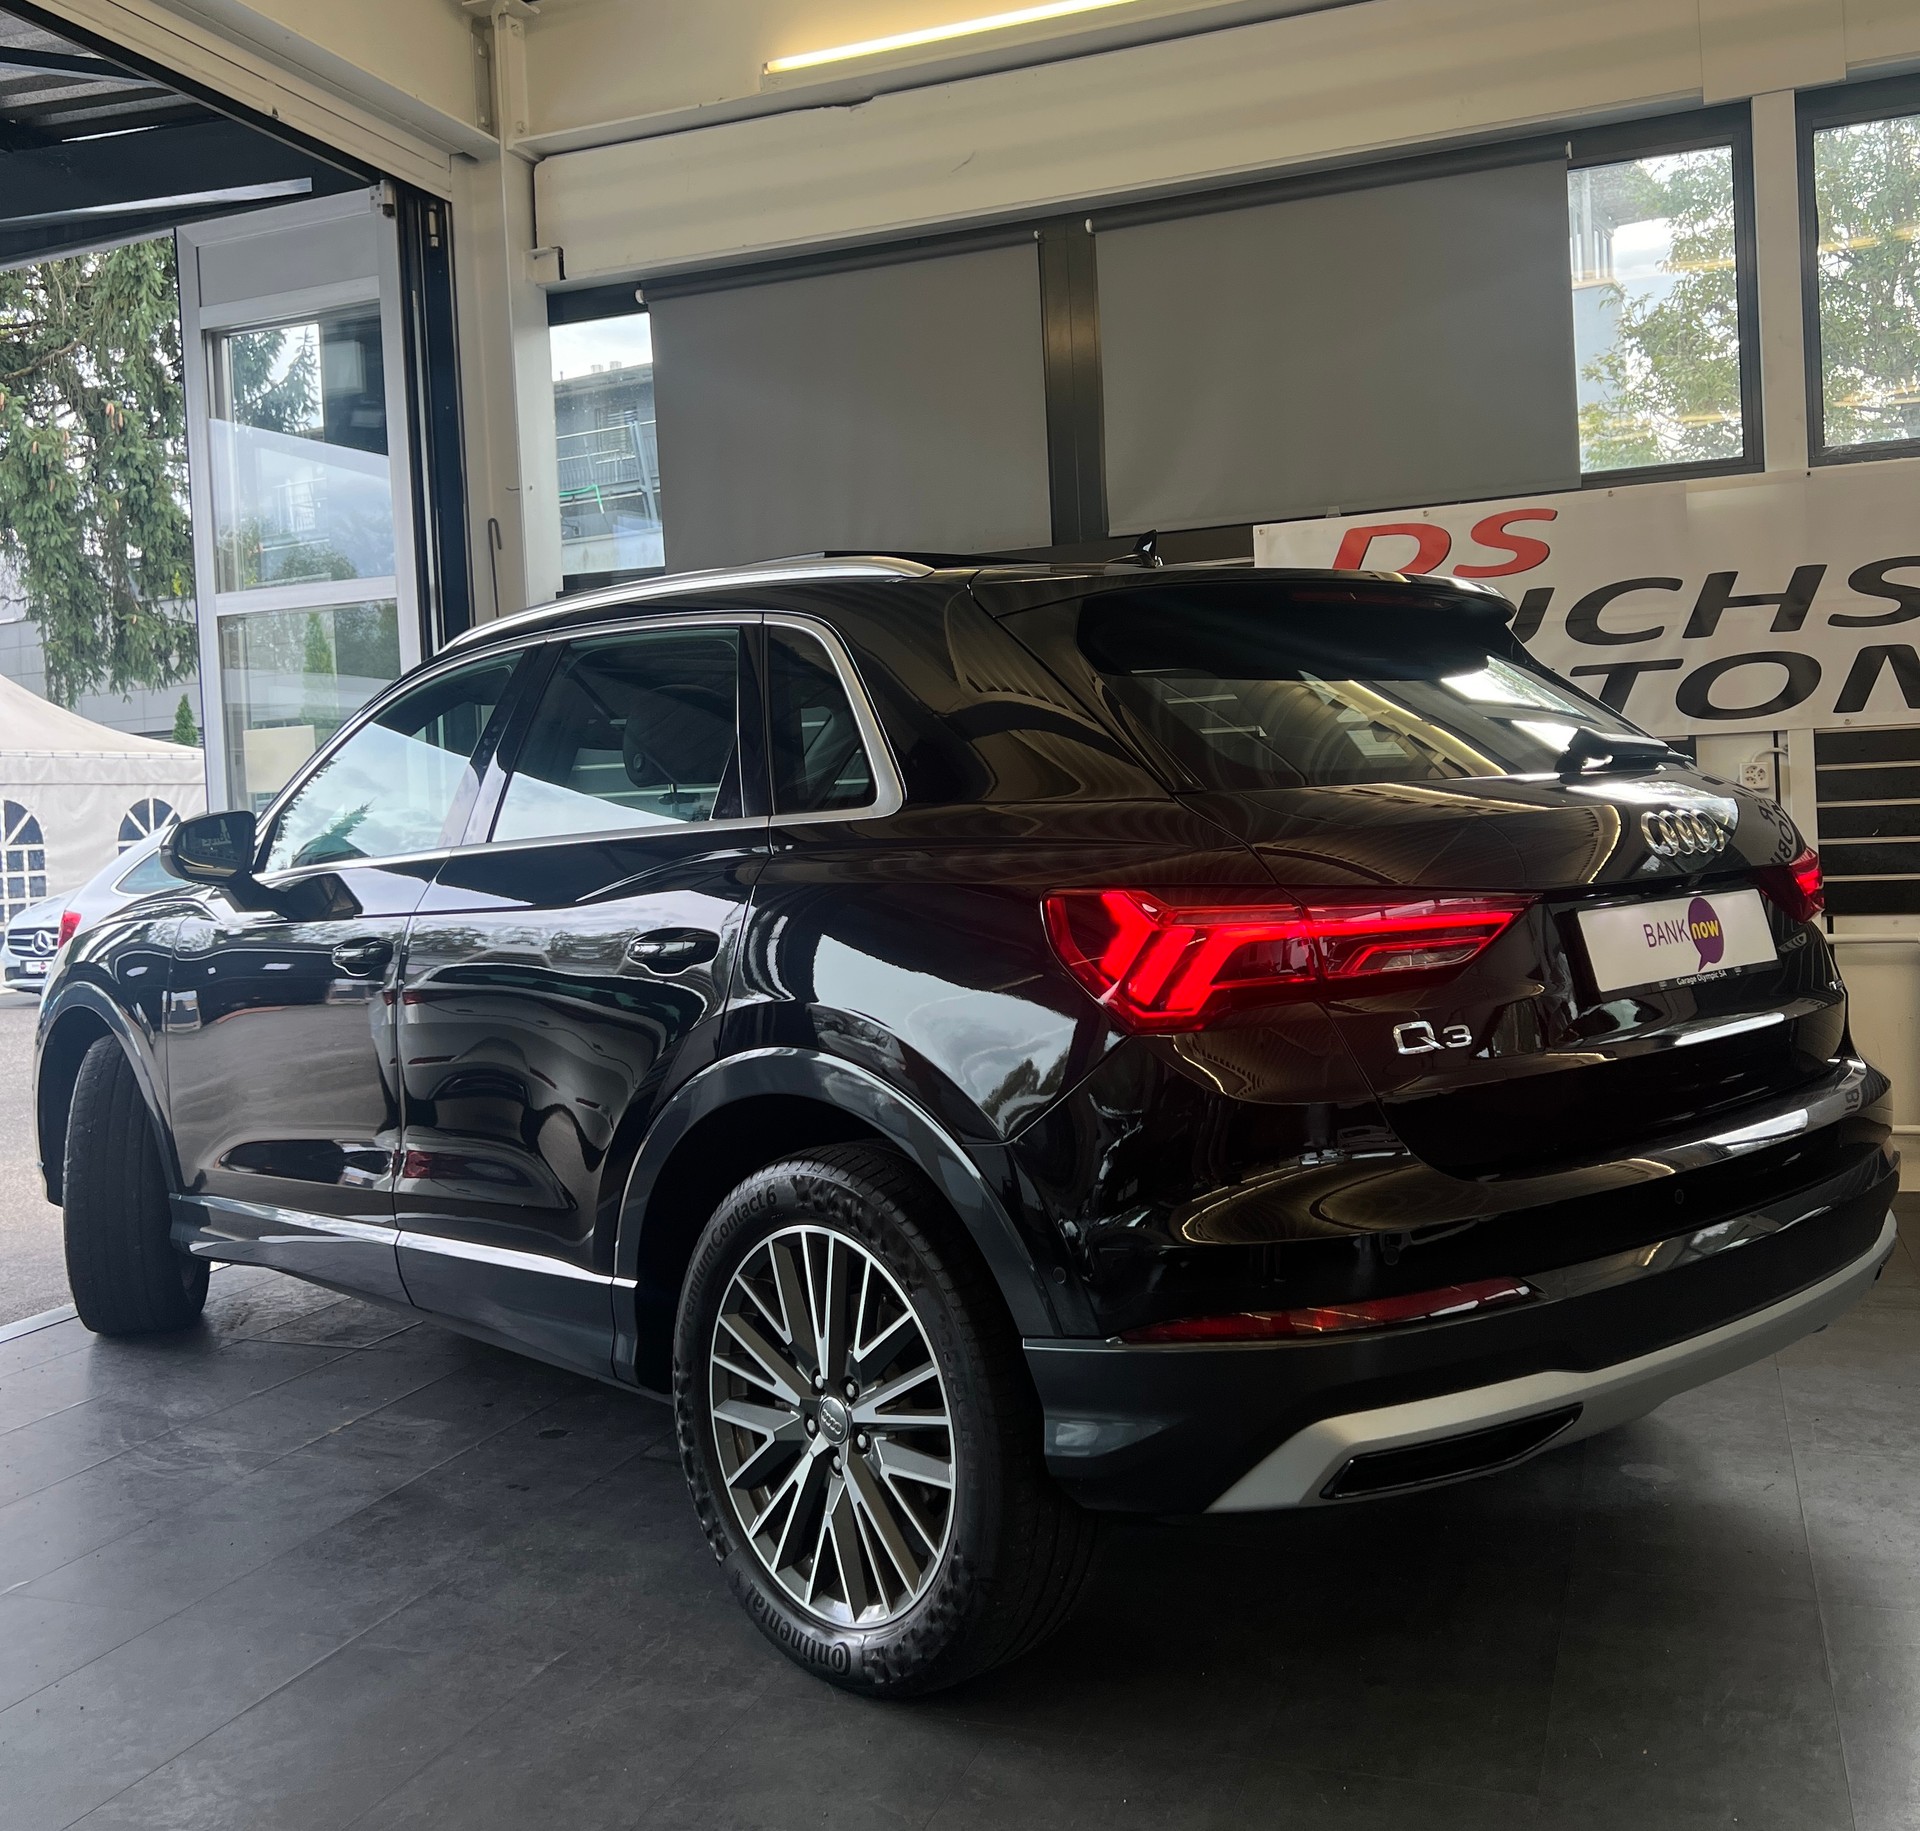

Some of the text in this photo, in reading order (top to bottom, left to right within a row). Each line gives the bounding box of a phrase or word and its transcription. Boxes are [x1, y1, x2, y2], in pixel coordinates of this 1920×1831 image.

[1332, 508, 1558, 578] DS
[1643, 918, 1719, 948] BANK now
[1676, 974, 1698, 986] Garage
[1696, 971, 1719, 983] Olympic
[1393, 1020, 1473, 1055] Q3
[766, 1183, 778, 1207] 6
[744, 1582, 852, 1677] Continental
